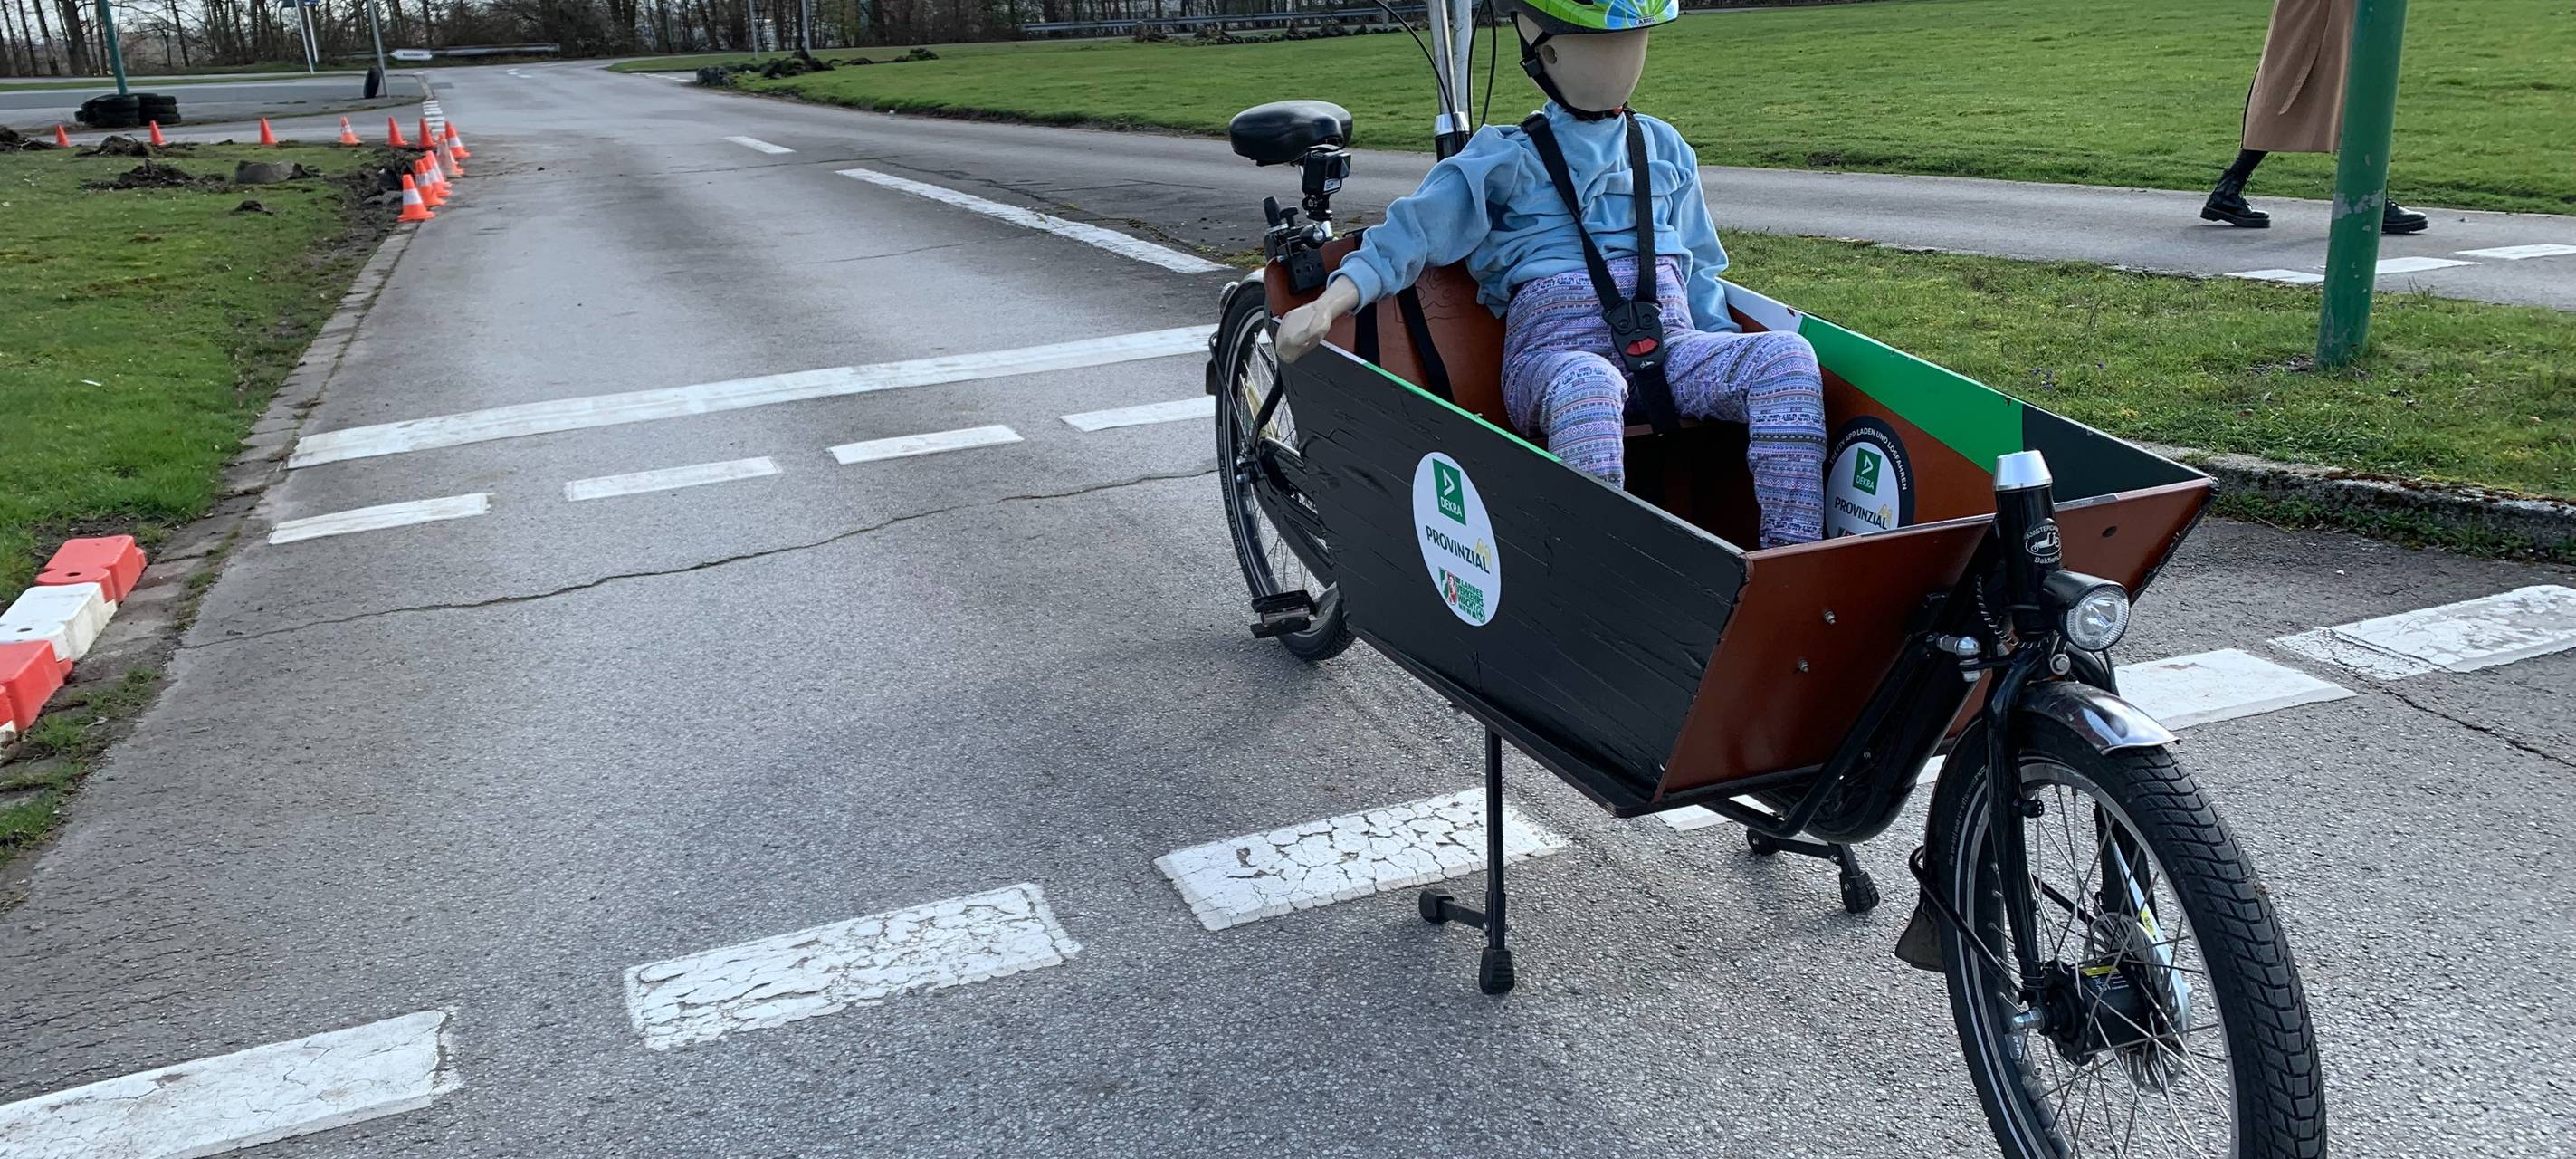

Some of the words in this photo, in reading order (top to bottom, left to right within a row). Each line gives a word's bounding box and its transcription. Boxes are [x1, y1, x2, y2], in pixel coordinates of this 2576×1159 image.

[1846, 430, 1856, 443] APP
[1856, 427, 1875, 436] LADEN
[1875, 430, 1888, 444] UND
[1887, 441, 1907, 491] LOSFAHREN
[1856, 474, 1875, 490] DEKRA
[1440, 496, 1463, 517] DEKRA
[1835, 496, 1887, 530] PROVINZIAL
[1426, 525, 1490, 574] PROVINZIAL
